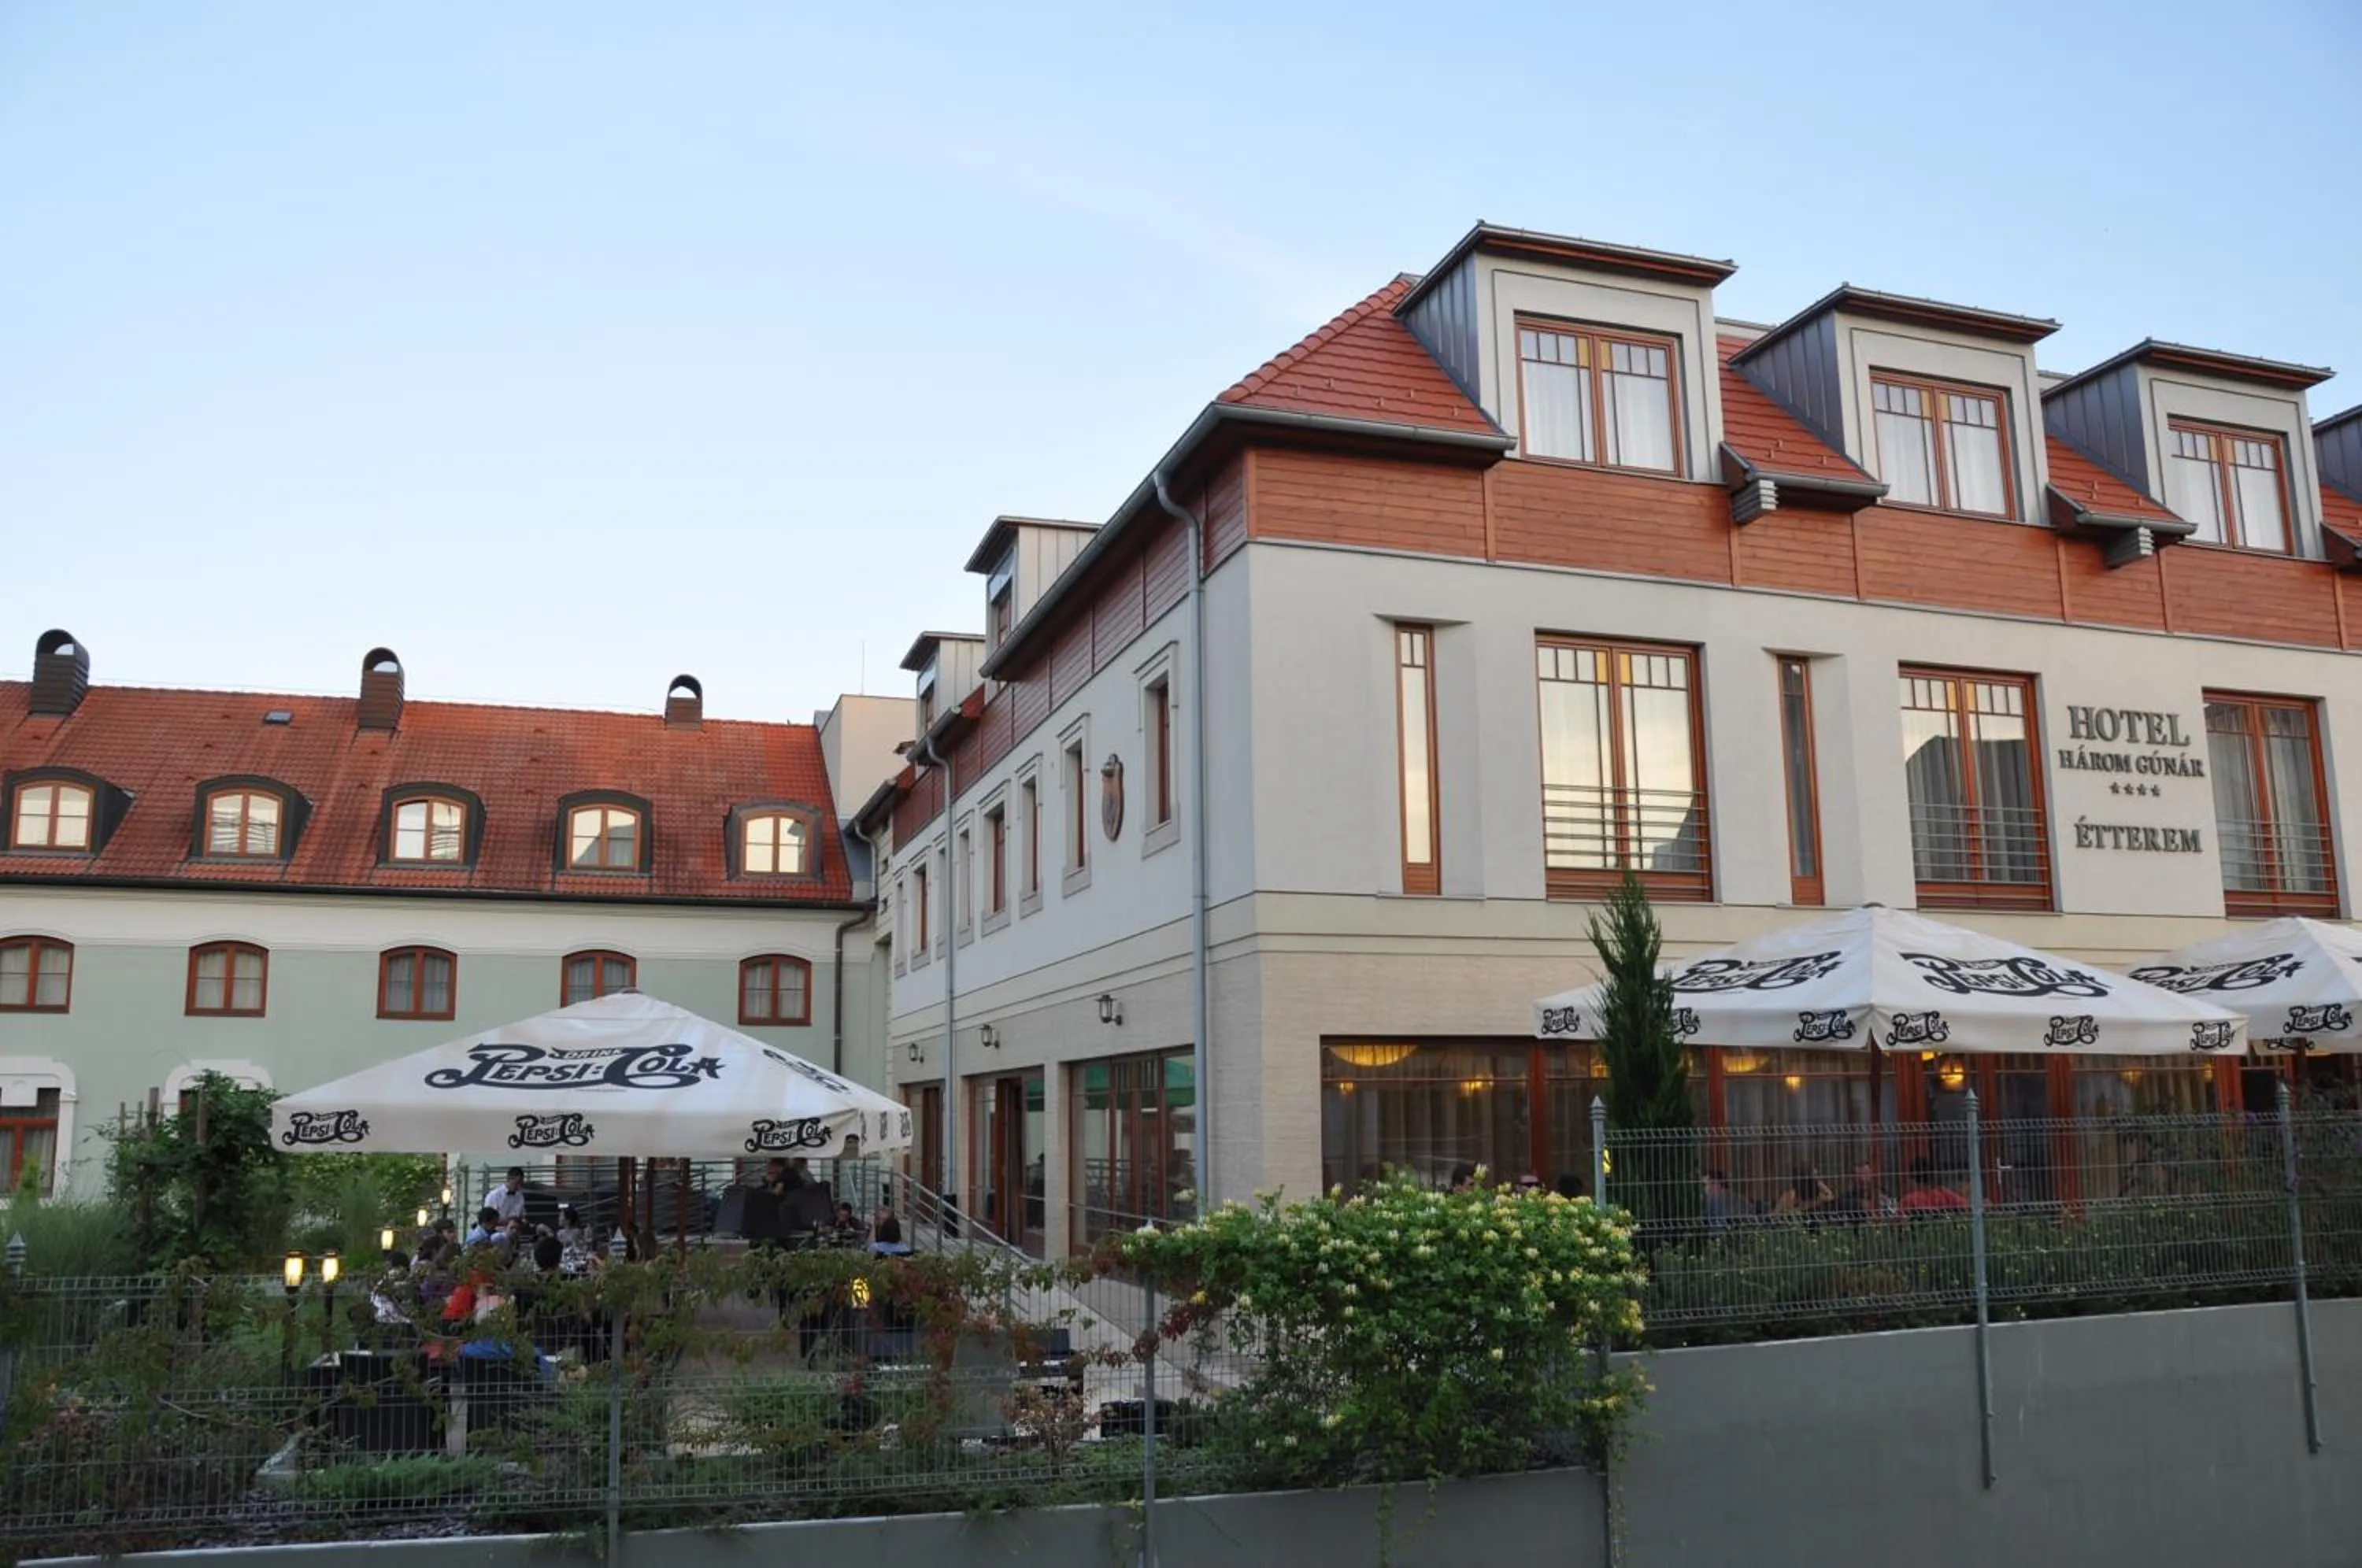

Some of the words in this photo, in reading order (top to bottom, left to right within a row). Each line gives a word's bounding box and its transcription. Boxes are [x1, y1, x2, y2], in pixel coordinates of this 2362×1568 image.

[2067, 705, 2191, 747] HOTEL
[2058, 744, 2131, 774] HÁROM
[2136, 749, 2205, 778] GÚNÁR
[2074, 815, 2203, 853] ÉTTEREM
[565, 1048, 624, 1060] DRINK
[603, 1043, 726, 1089] COLA
